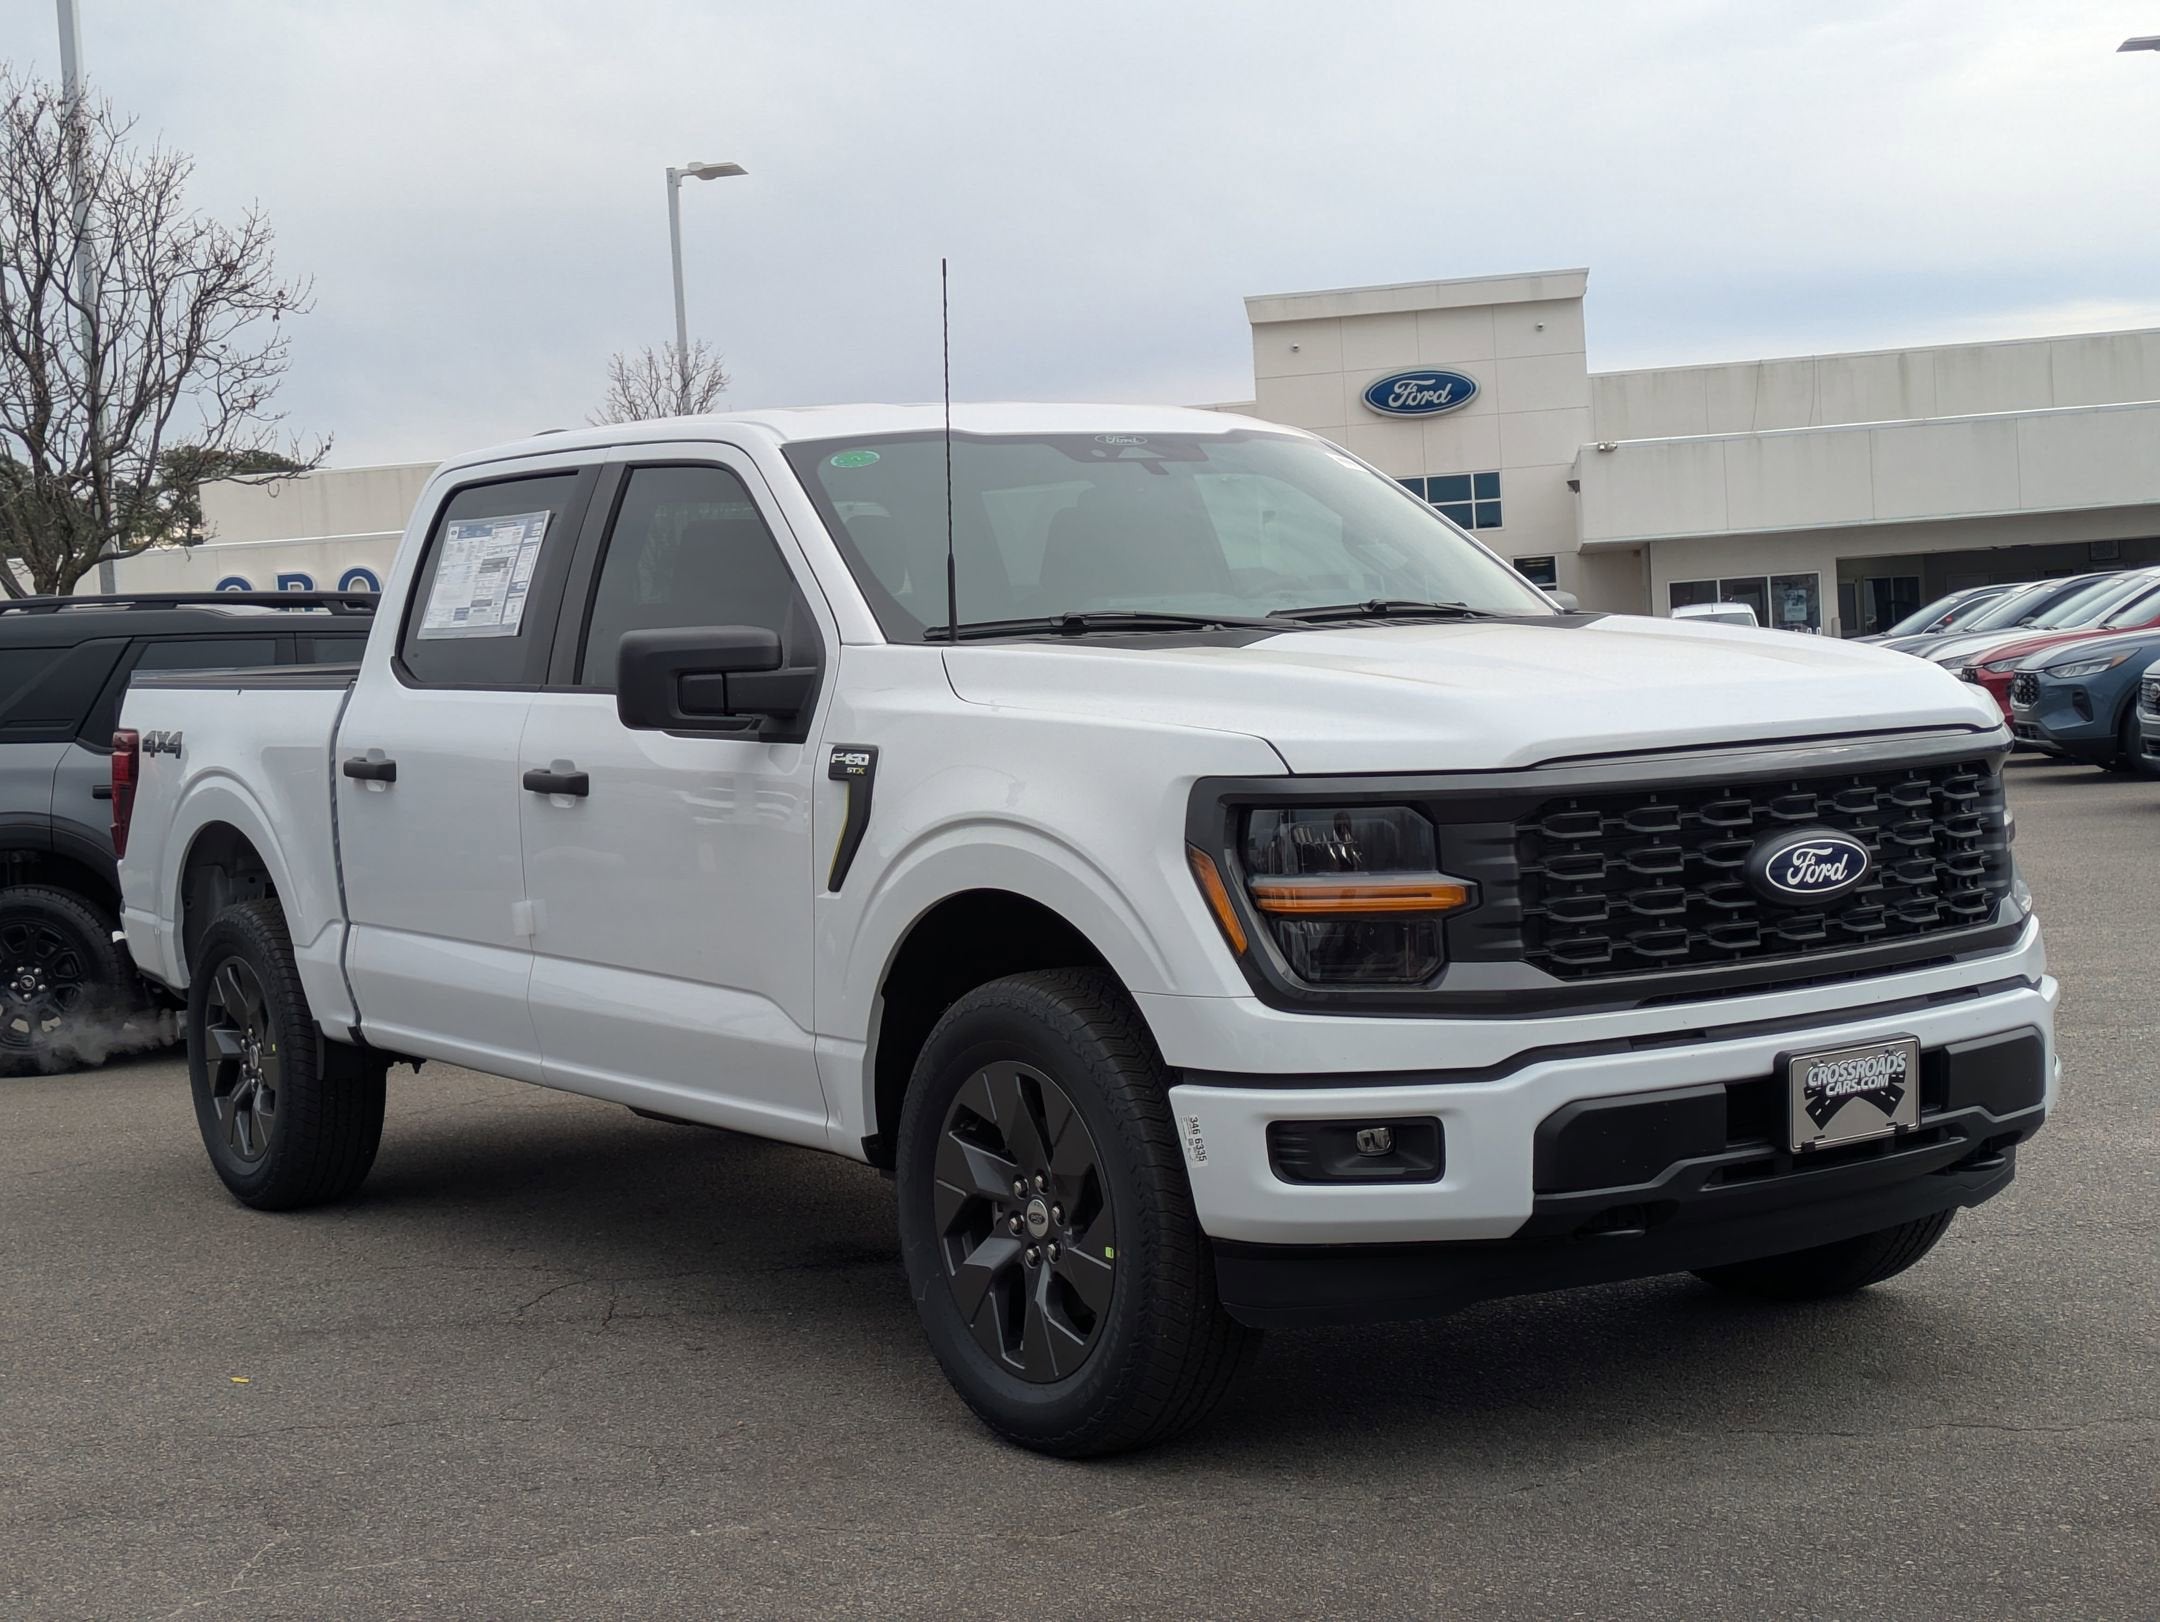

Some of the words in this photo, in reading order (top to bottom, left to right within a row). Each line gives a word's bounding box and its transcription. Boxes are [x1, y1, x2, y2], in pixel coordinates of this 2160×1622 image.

[1387, 378, 1453, 408] Ford
[1786, 847, 1849, 886] Ford
[1805, 1051, 1907, 1088] CROSSROADS
[1825, 1073, 1890, 1098] CARS.COM
